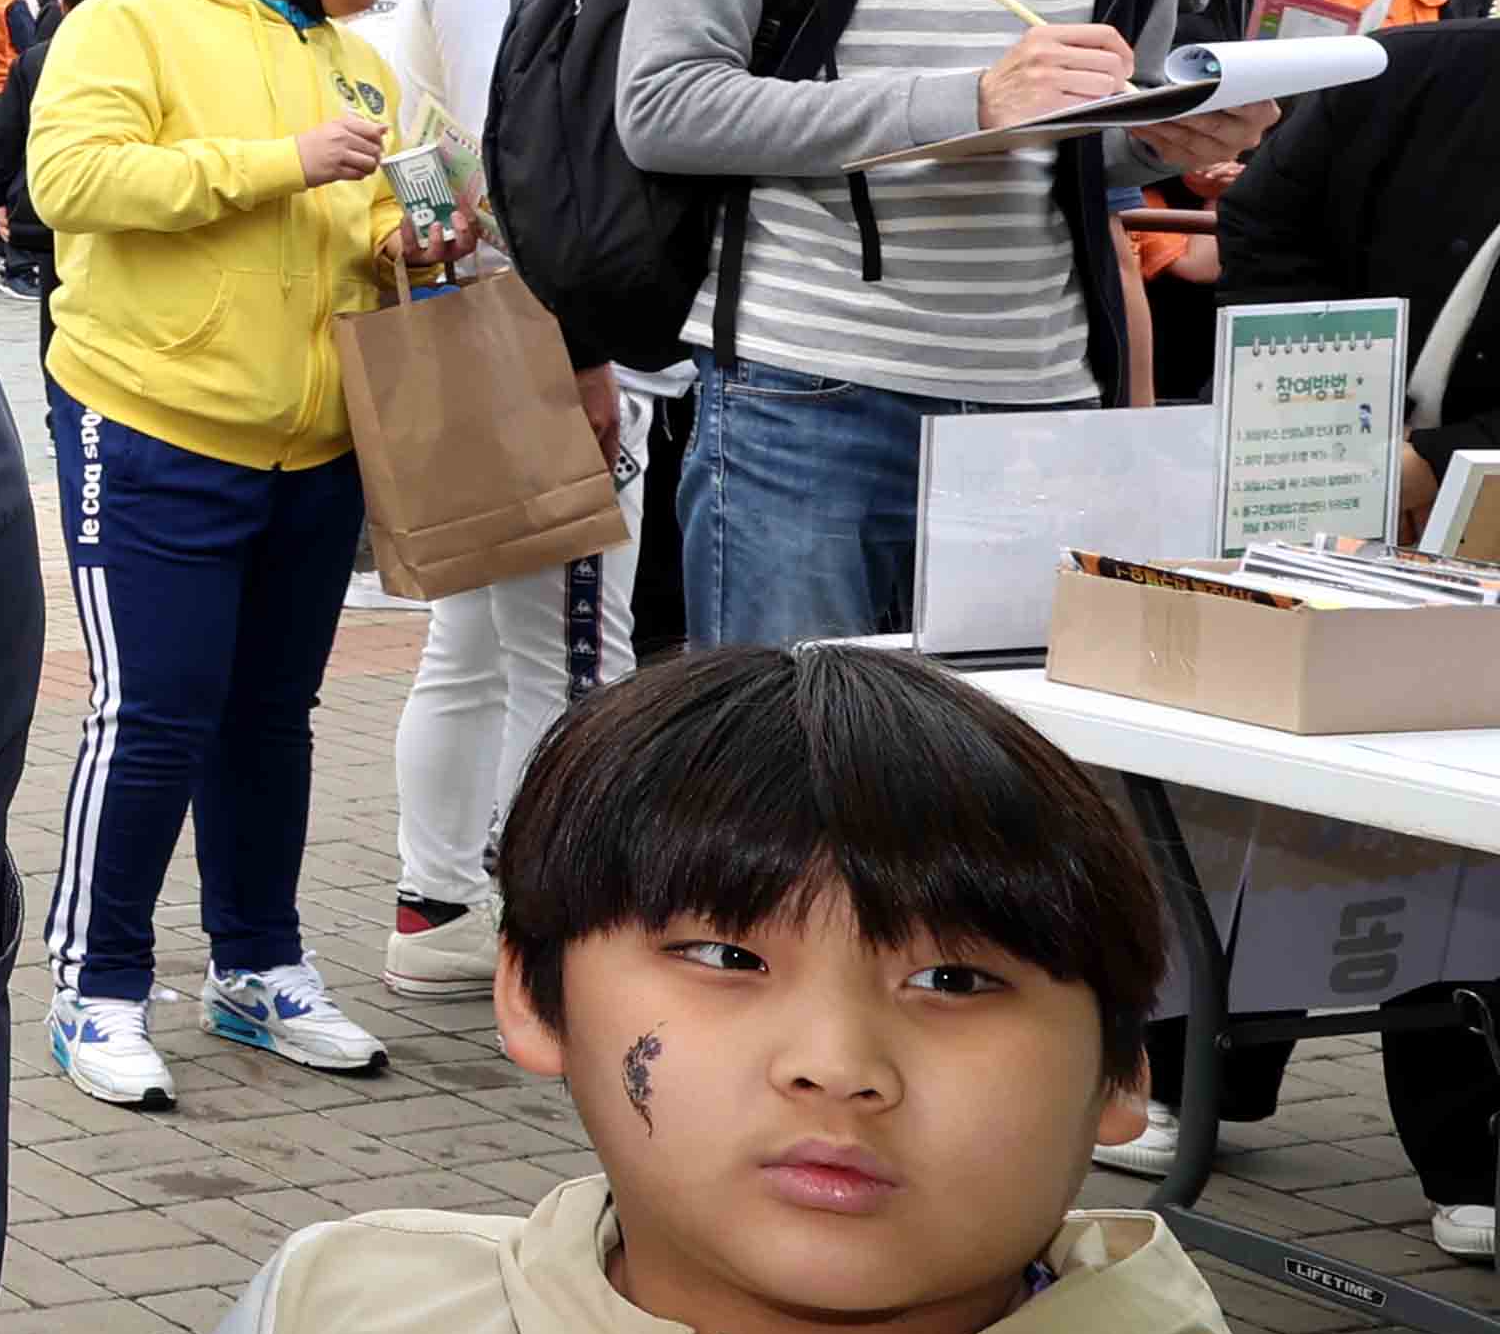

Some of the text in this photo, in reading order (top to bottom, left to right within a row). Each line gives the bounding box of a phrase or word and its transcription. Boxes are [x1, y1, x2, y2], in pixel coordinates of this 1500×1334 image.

[1276, 372, 1348, 403] 참여방법
[81, 463, 103, 515] coq
[77, 517, 100, 544] le
